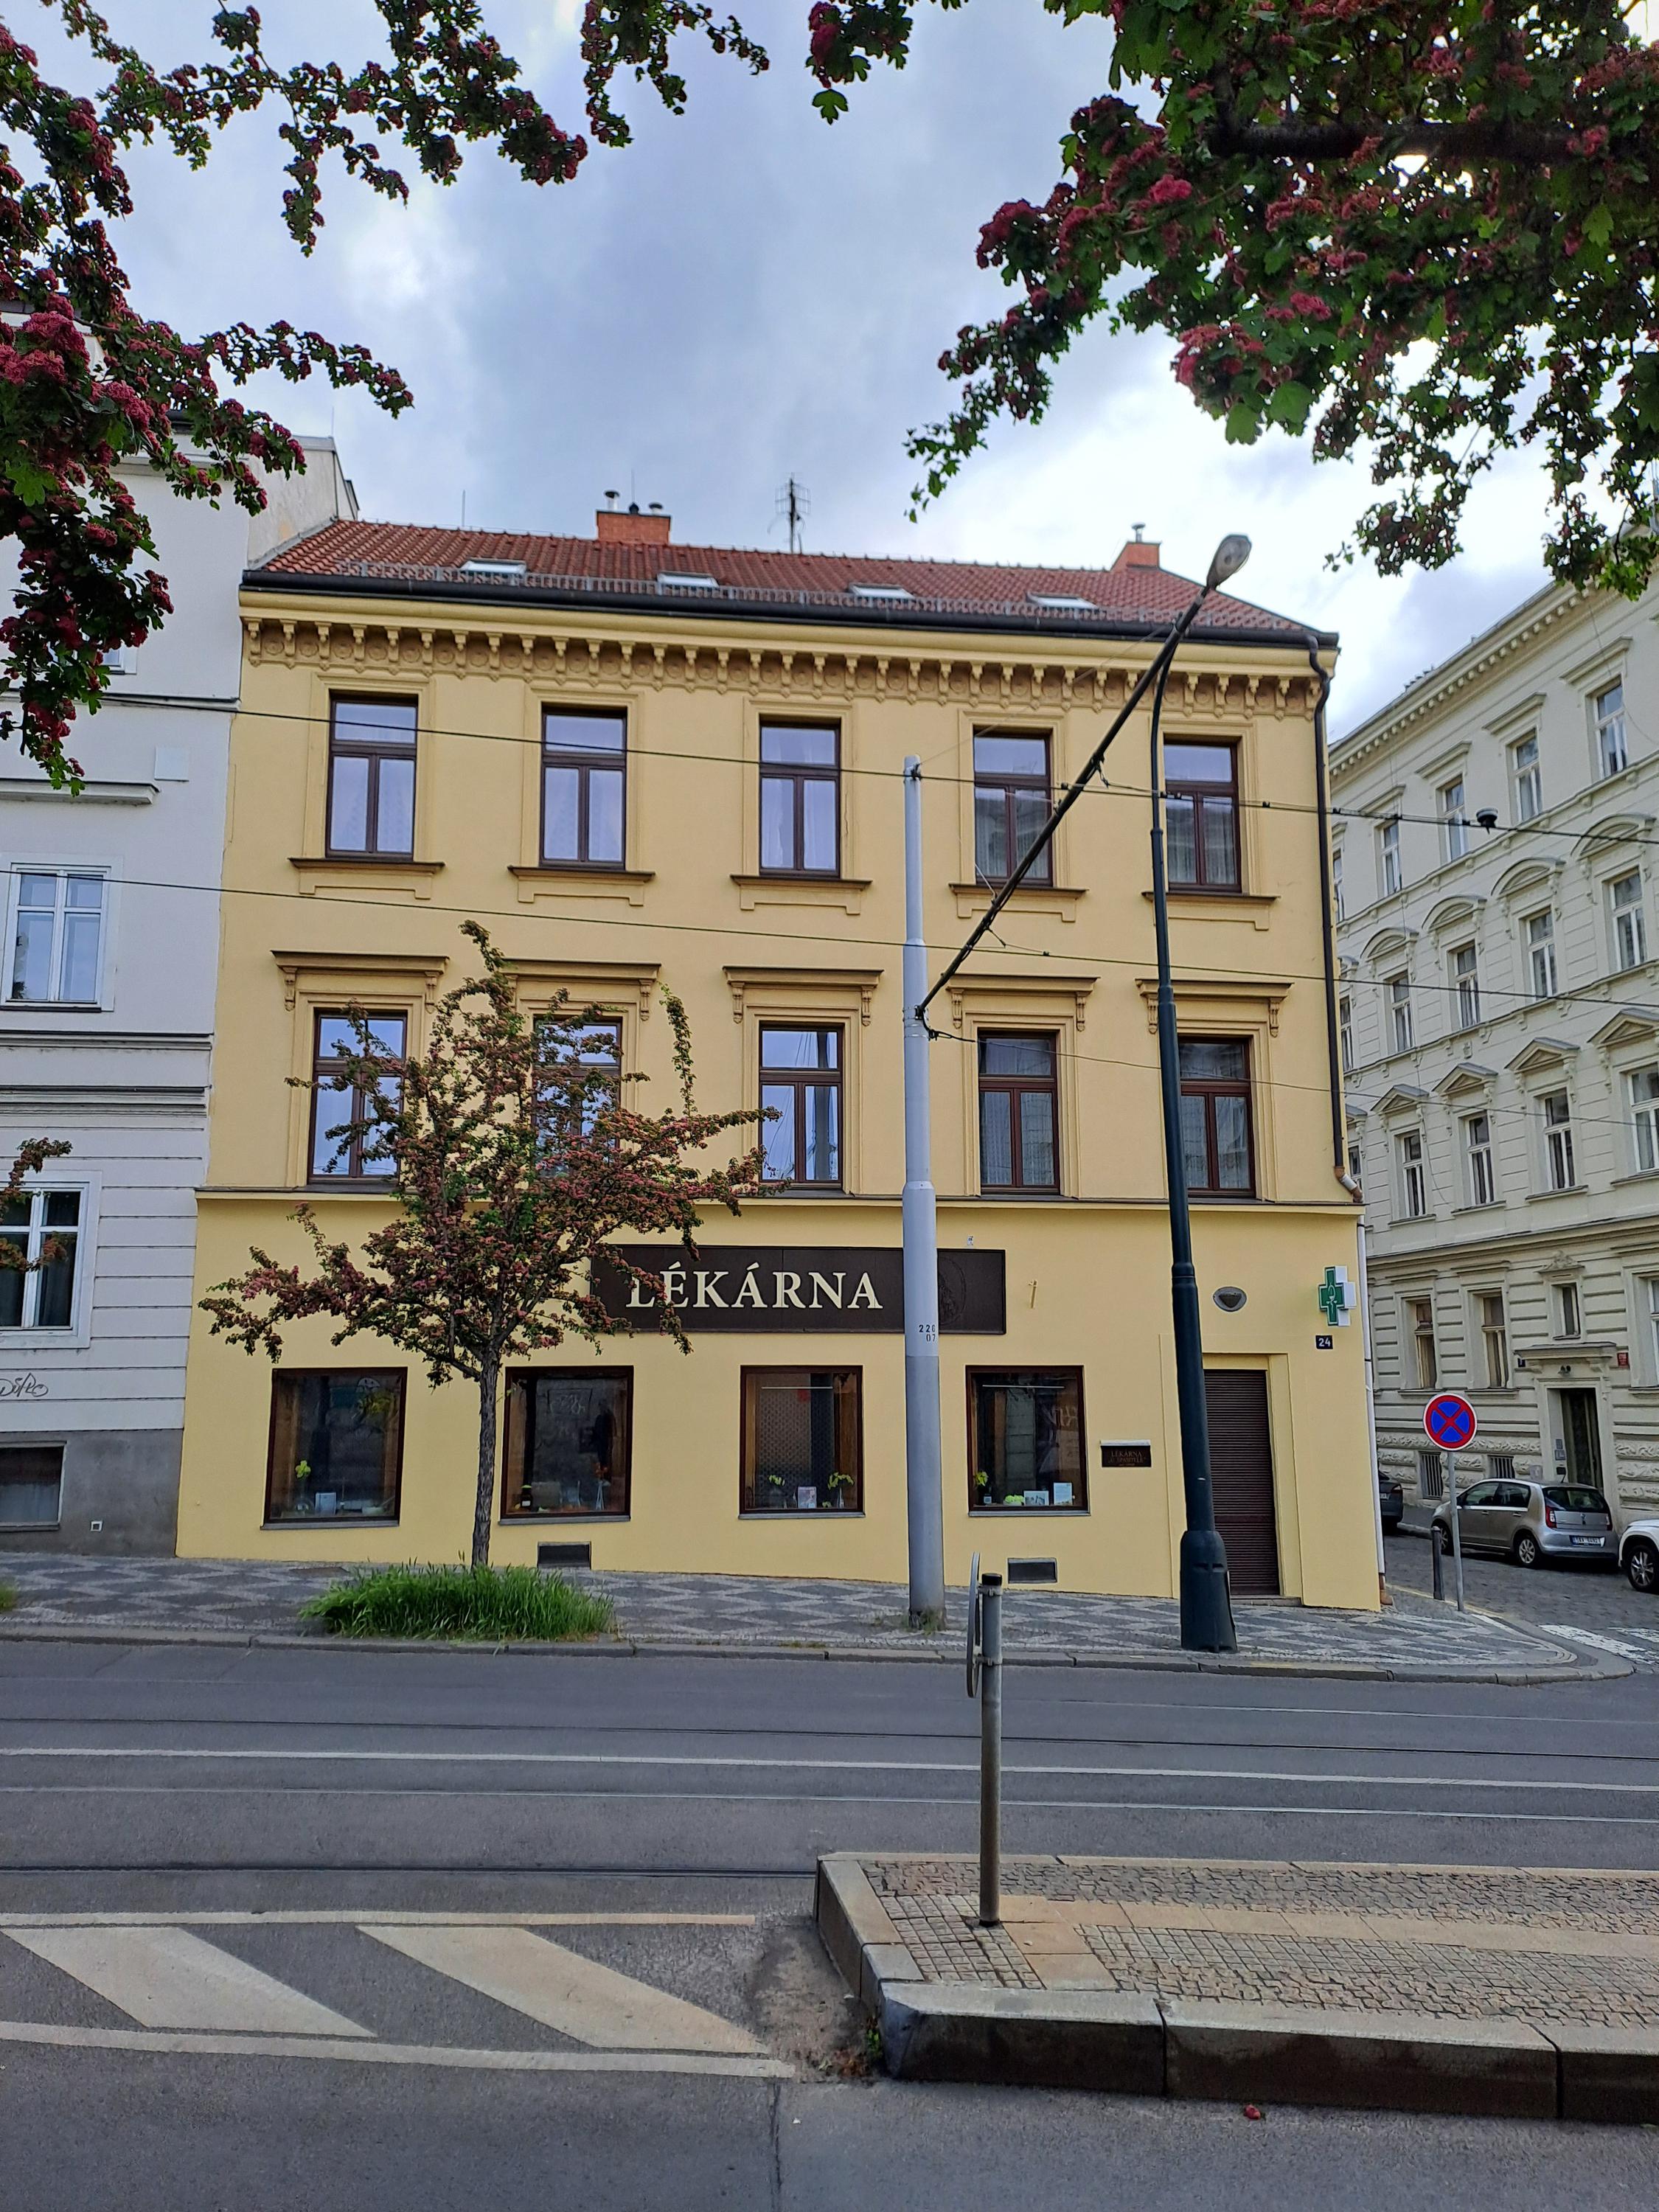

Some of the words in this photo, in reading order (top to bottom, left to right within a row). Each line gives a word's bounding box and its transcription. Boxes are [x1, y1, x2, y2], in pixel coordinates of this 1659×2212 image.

[625, 1261, 883, 1309] LÉKÁRNA
[926, 1333, 936, 1343] 07
[1318, 1337, 1331, 1347] 24
